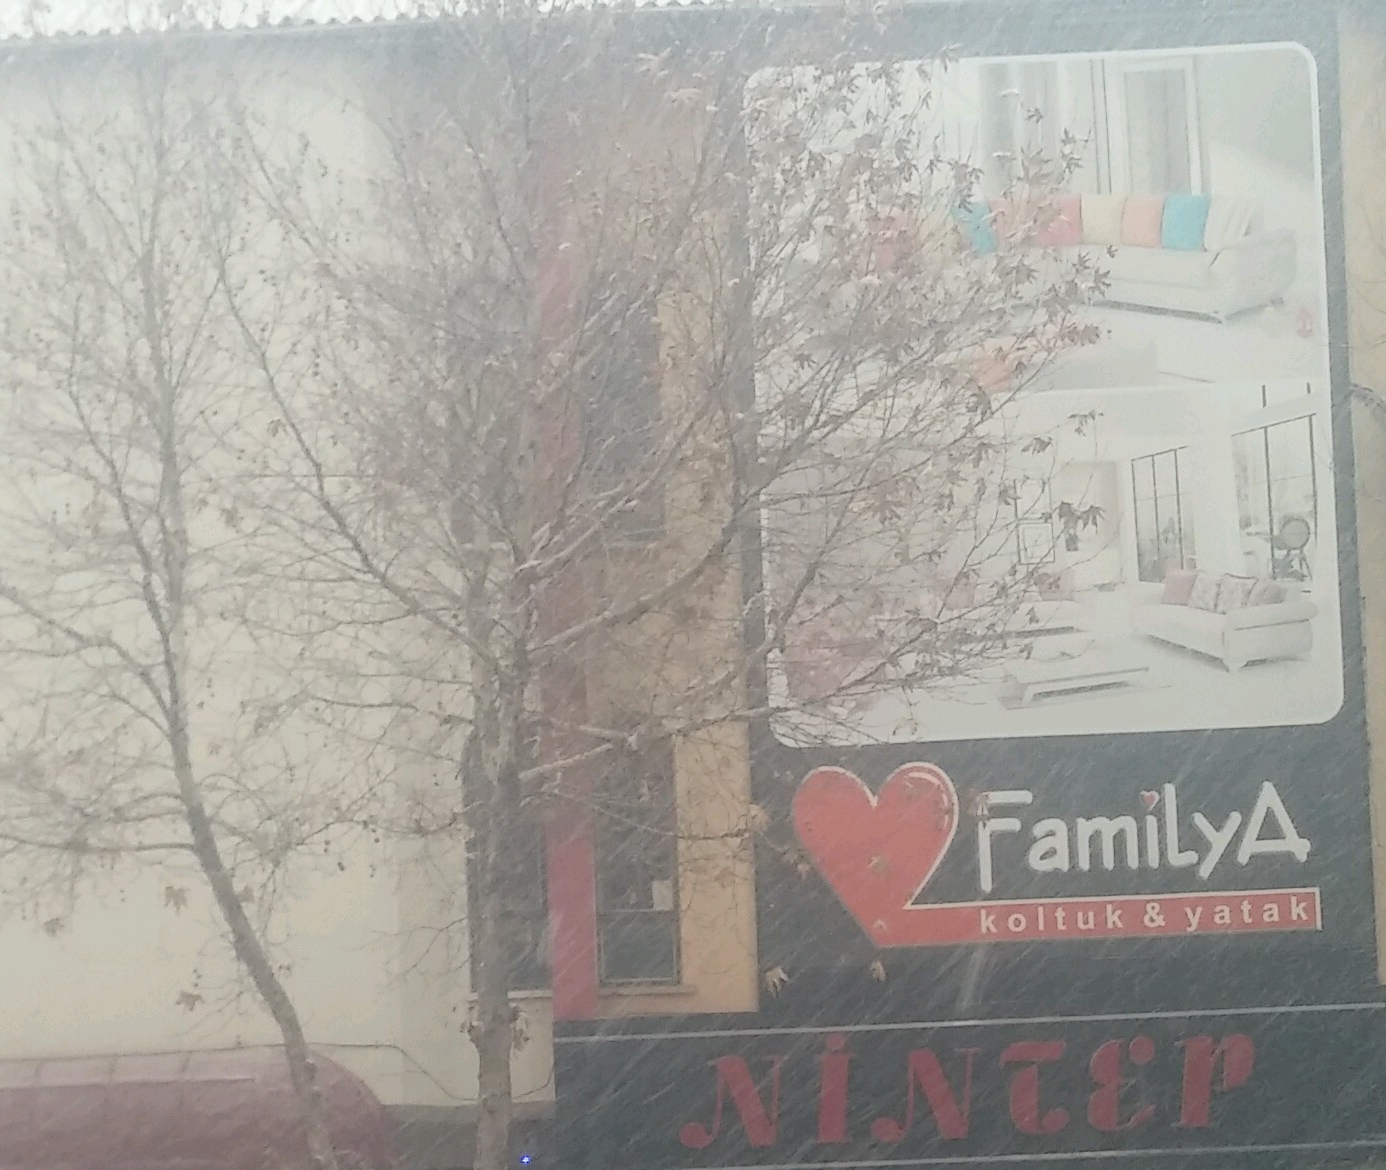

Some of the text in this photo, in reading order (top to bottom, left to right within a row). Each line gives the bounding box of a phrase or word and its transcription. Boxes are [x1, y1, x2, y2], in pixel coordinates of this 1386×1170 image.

[979, 895, 1309, 933] koltuk & yatak
